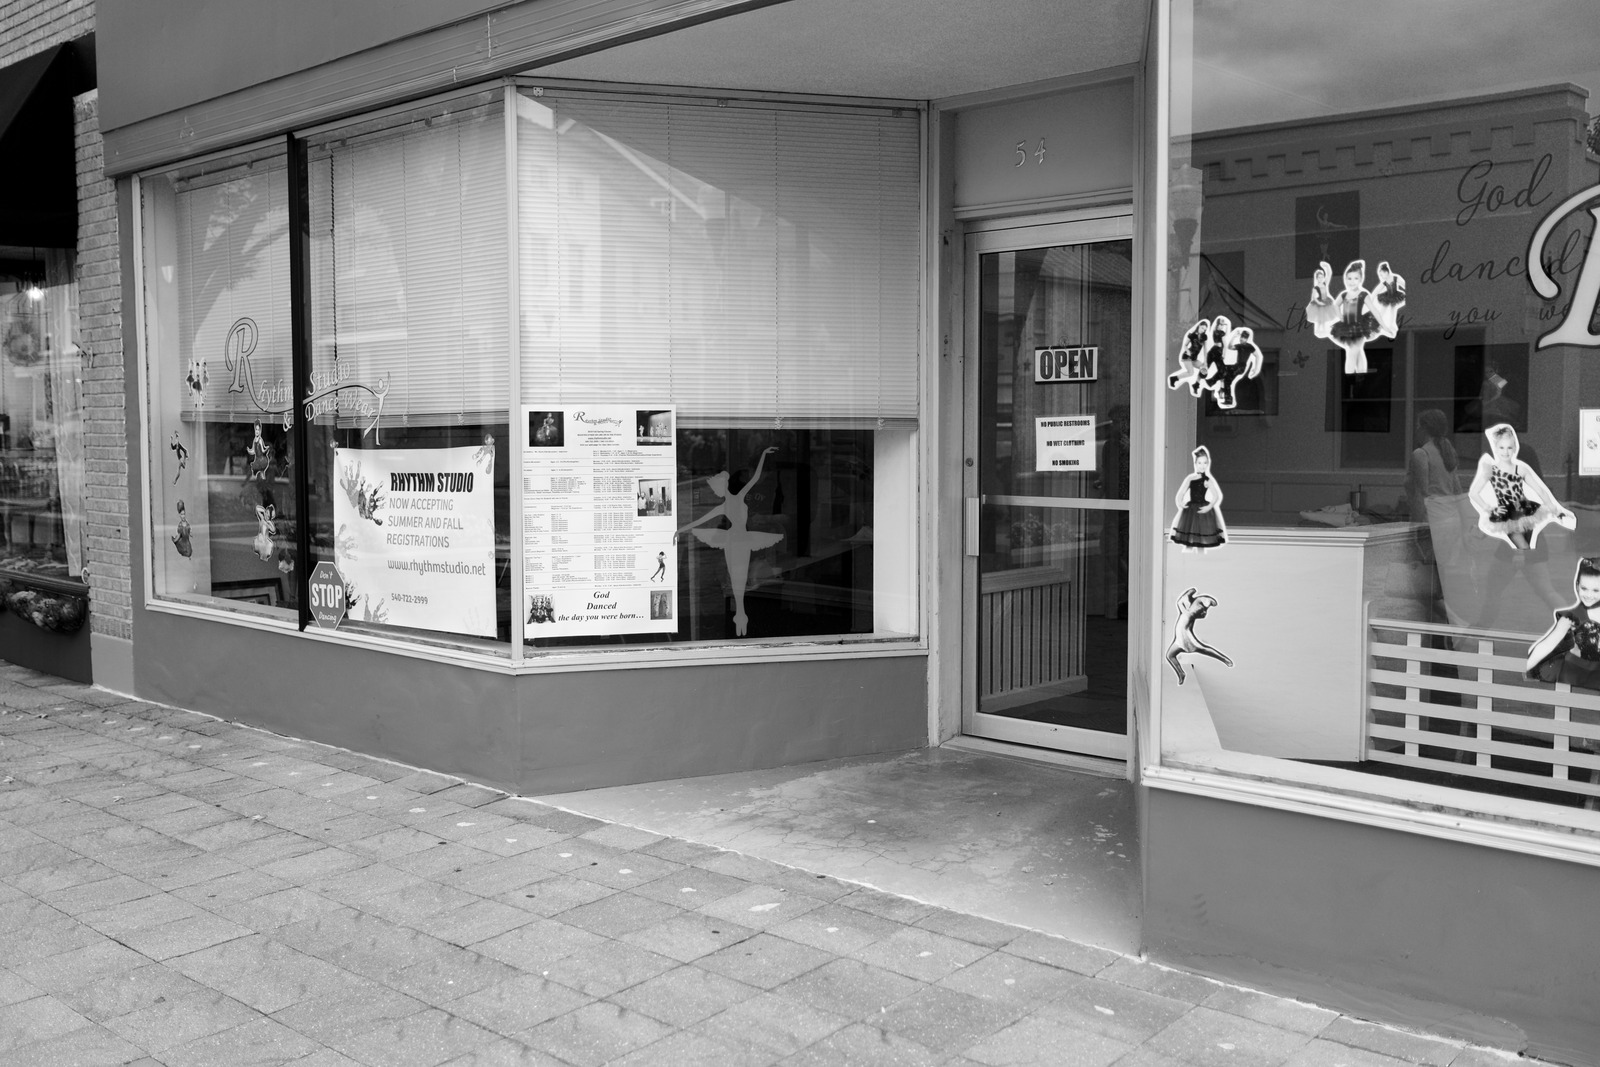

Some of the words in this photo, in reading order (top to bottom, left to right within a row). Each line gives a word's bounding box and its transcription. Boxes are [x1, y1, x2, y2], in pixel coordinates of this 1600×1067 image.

[1015, 138, 1046, 168] 54
[1456, 153, 1553, 226] God
[1421, 229, 1583, 285] dancd
[1443, 307, 1503, 340] you
[1040, 349, 1094, 380] OPEN
[308, 357, 350, 396] Studio
[283, 412, 292, 432] &
[305, 397, 339, 421] Dance
[342, 388, 376, 418] Wear
[390, 472, 435, 492] RHYTHM
[437, 472, 474, 493] STUDIO
[389, 497, 409, 509] NOW
[410, 498, 454, 511] ACCEPTING
[388, 515, 423, 528] SUMMER
[424, 517, 441, 529] AND
[442, 518, 464, 530] FALL
[386, 533, 450, 548] REGISTRATIONS
[319, 570, 333, 579] Don't
[387, 559, 486, 576] www.rhythmstudio.net
[311, 582, 343, 608] STOP
[391, 593, 429, 605] 540-722-2999
[593, 591, 610, 599] God
[586, 602, 617, 610] Danced
[318, 611, 337, 624] Dancing
[571, 614, 584, 622] day
[585, 614, 599, 622] you
